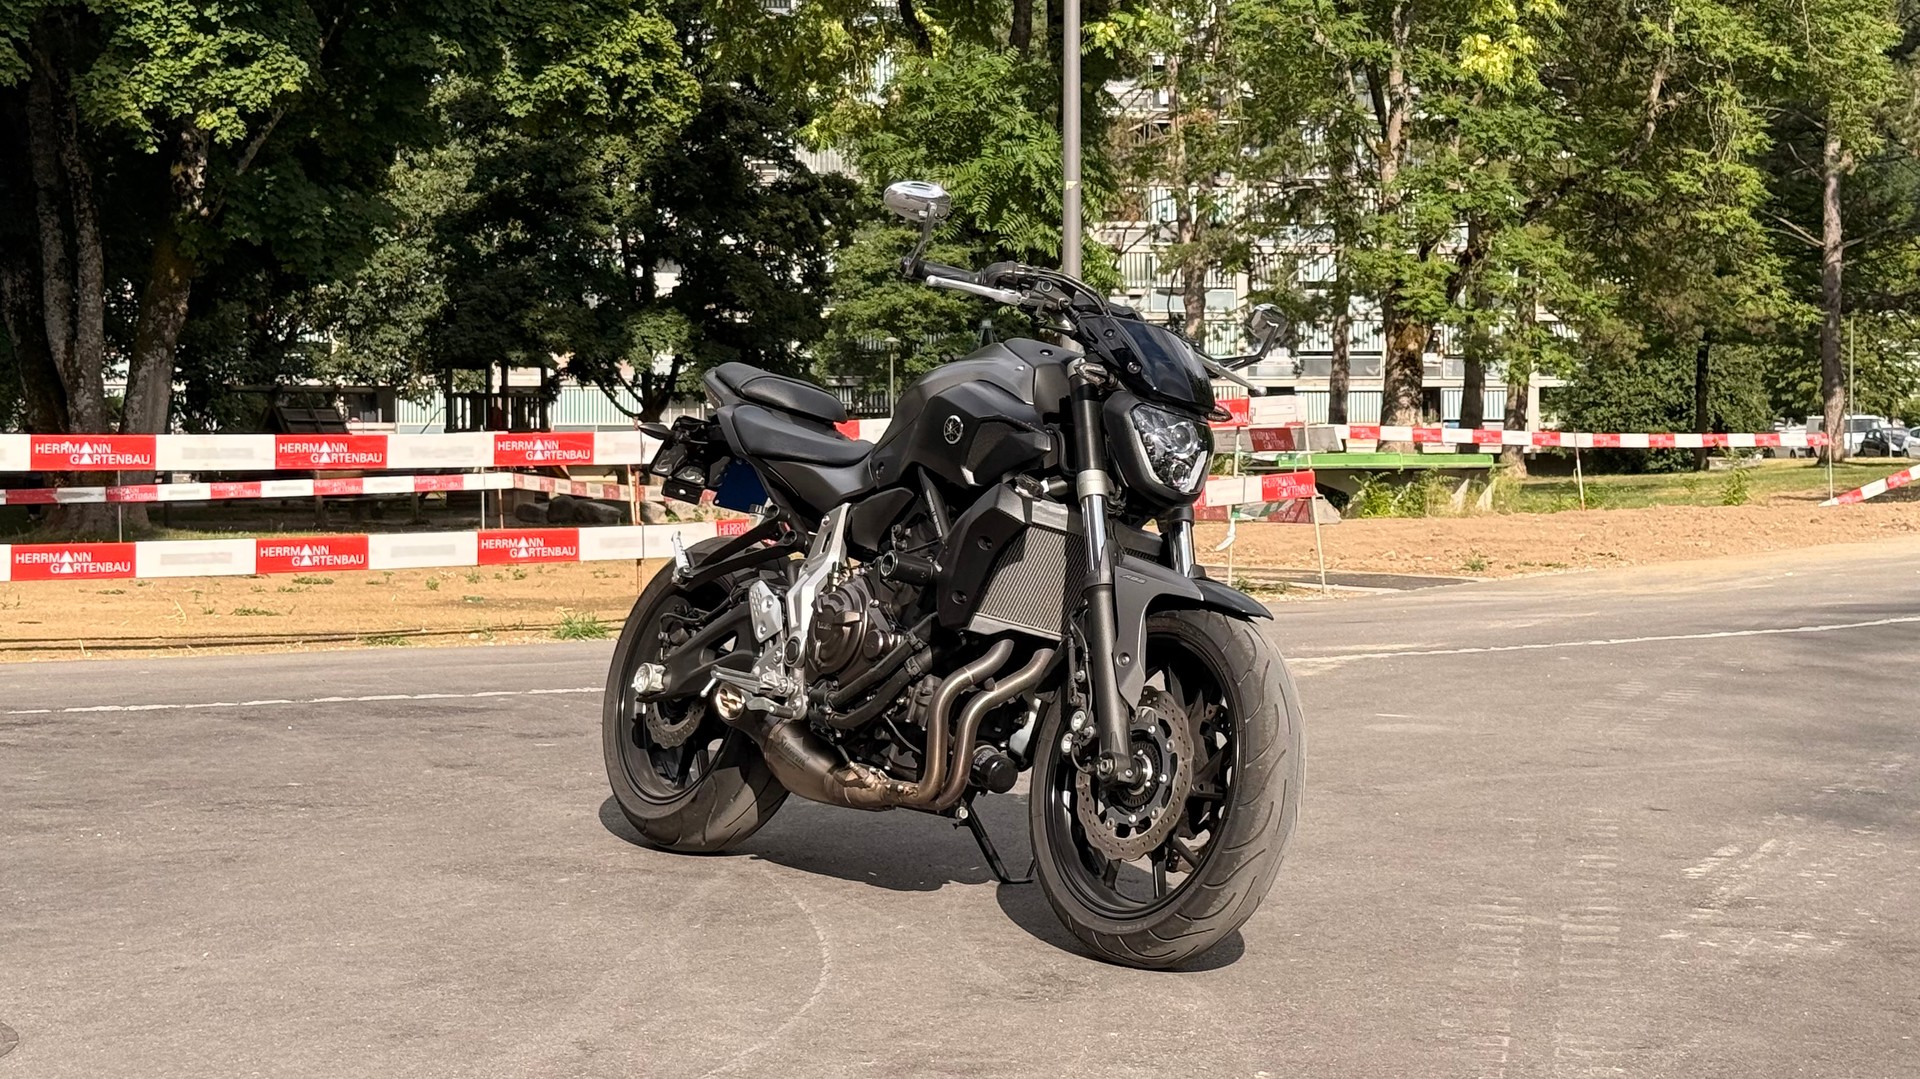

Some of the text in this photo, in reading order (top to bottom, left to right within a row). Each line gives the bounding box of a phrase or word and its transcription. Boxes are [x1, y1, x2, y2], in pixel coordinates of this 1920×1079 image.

[35, 442, 112, 454] HERRMANN
[279, 441, 348, 453] HERRMANN
[497, 439, 559, 451] HERRMANN
[69, 453, 151, 465] GARTENBAU
[310, 452, 383, 463] GARTENBAU
[525, 449, 591, 460] GARTENBAU
[481, 537, 544, 549] HERRMANN
[260, 544, 329, 557] HERRMANN
[509, 546, 576, 558] GARTENBAU
[15, 551, 92, 564] HERRMANN
[291, 555, 365, 566] GARTENBAU
[50, 562, 131, 574] GARTENBAU
